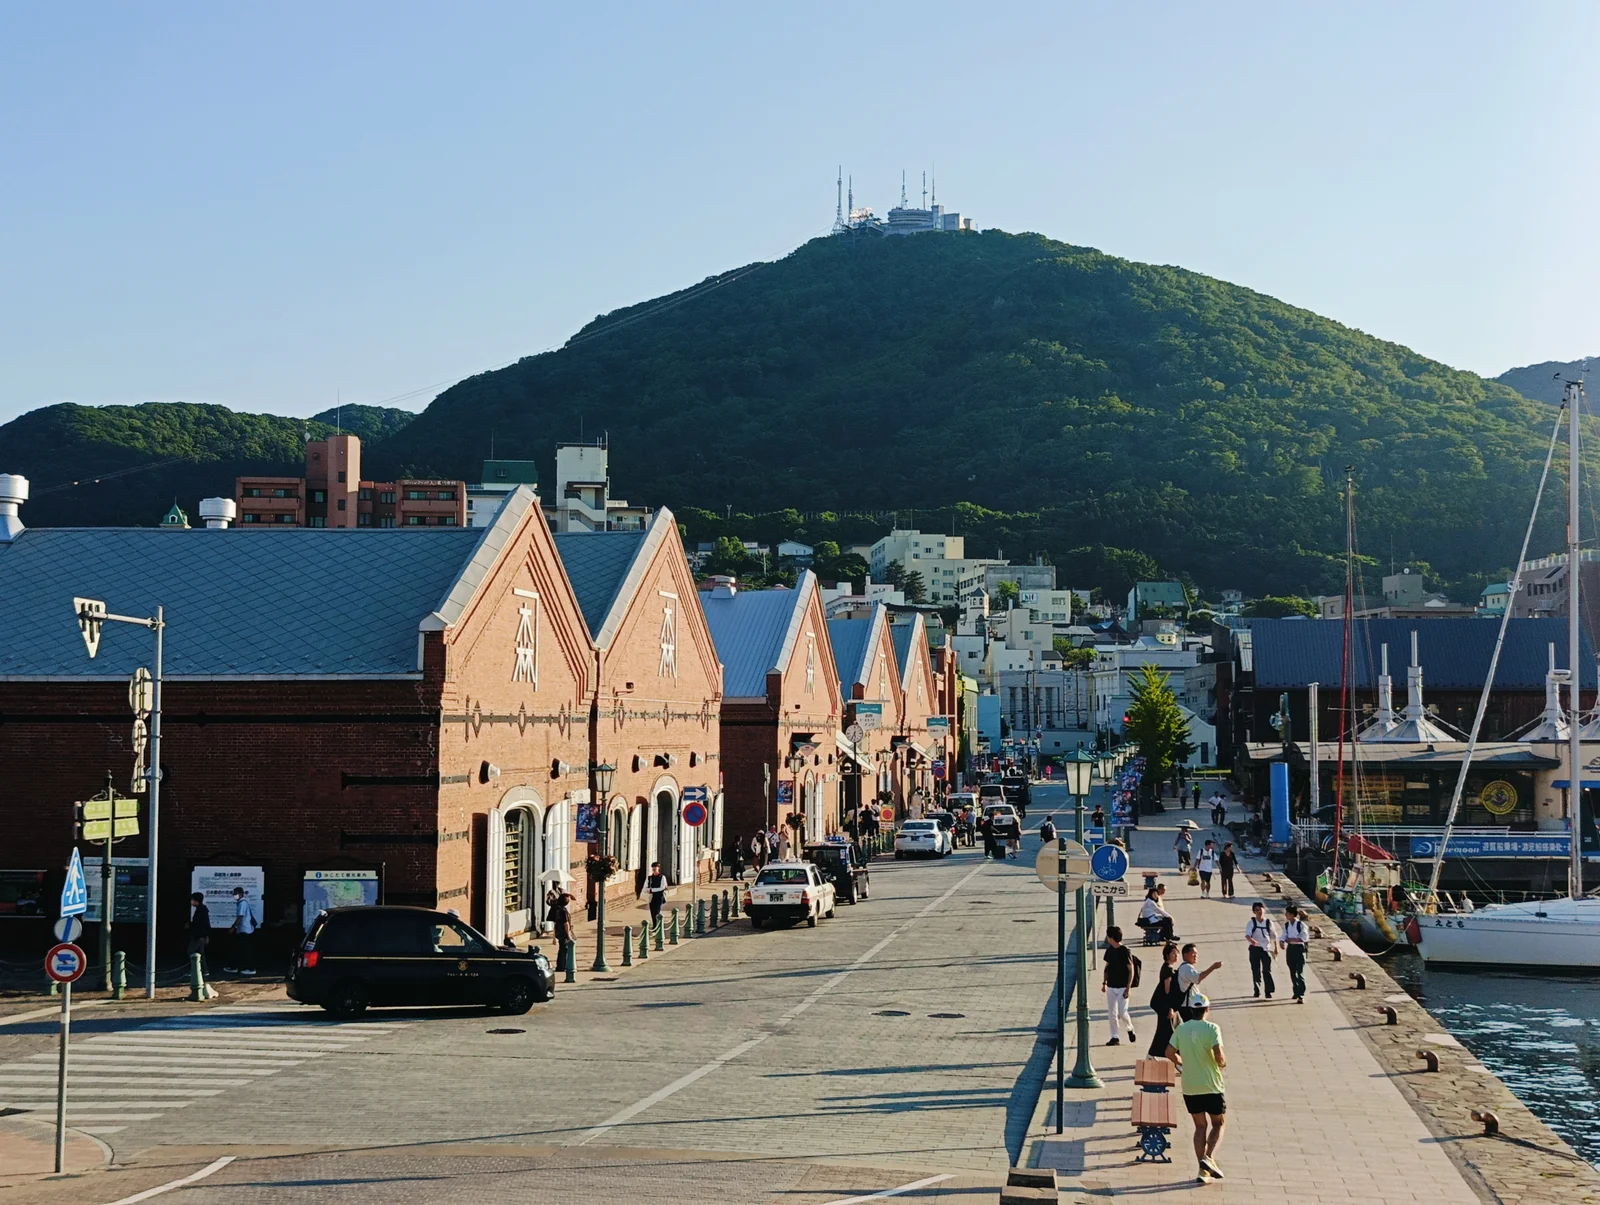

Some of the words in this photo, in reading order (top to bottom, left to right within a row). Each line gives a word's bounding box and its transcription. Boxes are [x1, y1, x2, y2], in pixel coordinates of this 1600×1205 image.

[1093, 885, 1126, 895] ここから
[1435, 918, 1465, 928] えとも
